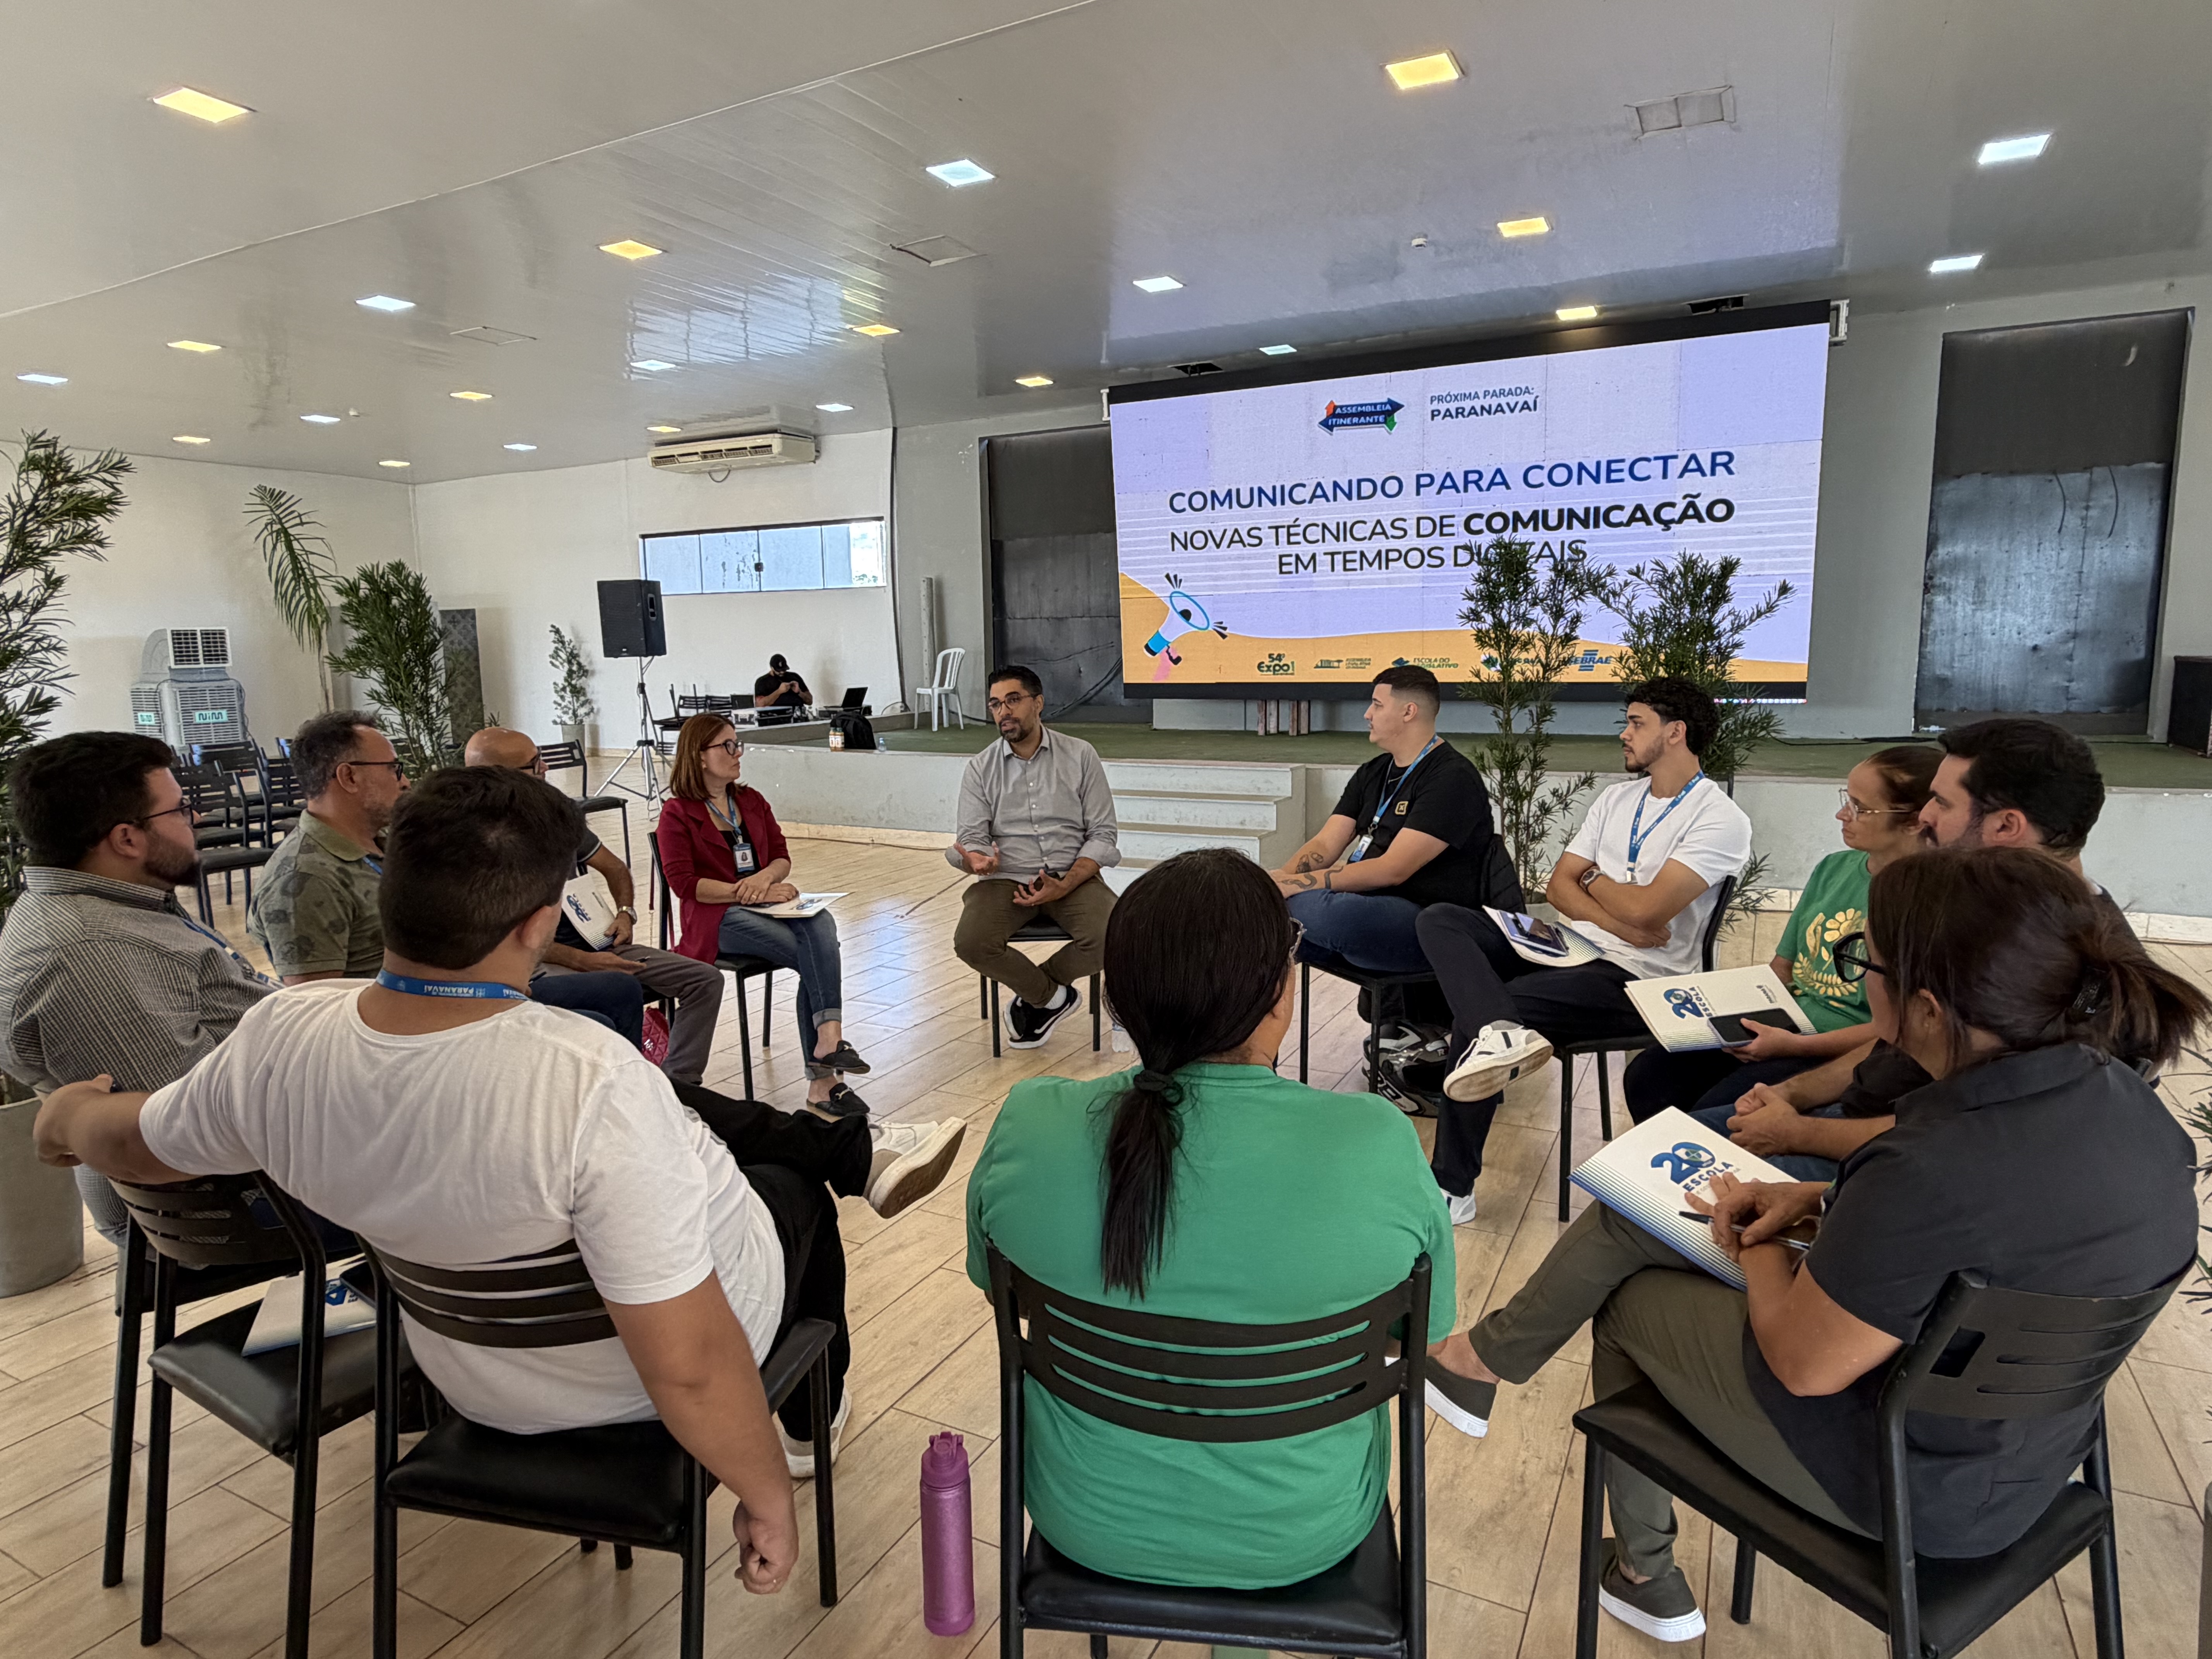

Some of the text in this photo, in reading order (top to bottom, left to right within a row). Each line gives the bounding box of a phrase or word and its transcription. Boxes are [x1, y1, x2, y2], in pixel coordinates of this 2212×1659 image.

[1335, 404, 1392, 414] ASSEMBLEIA
[1430, 386, 1534, 405] PRÓXIMA PARADA:
[1431, 396, 1539, 421] PARANAVAÍ
[1328, 415, 1385, 426] ITINERANTE
[1169, 451, 1735, 513] COMUNICANDO PARA CONECTAR
[1171, 493, 1735, 551] NOVAS TÉCNICAS DE COMUNICAÇÃO
[1279, 552, 1316, 575] EM
[1323, 546, 1445, 572] TEMPOS
[1651, 1142, 1716, 1185] 20
[1682, 1161, 1734, 1192] ESCOLA
